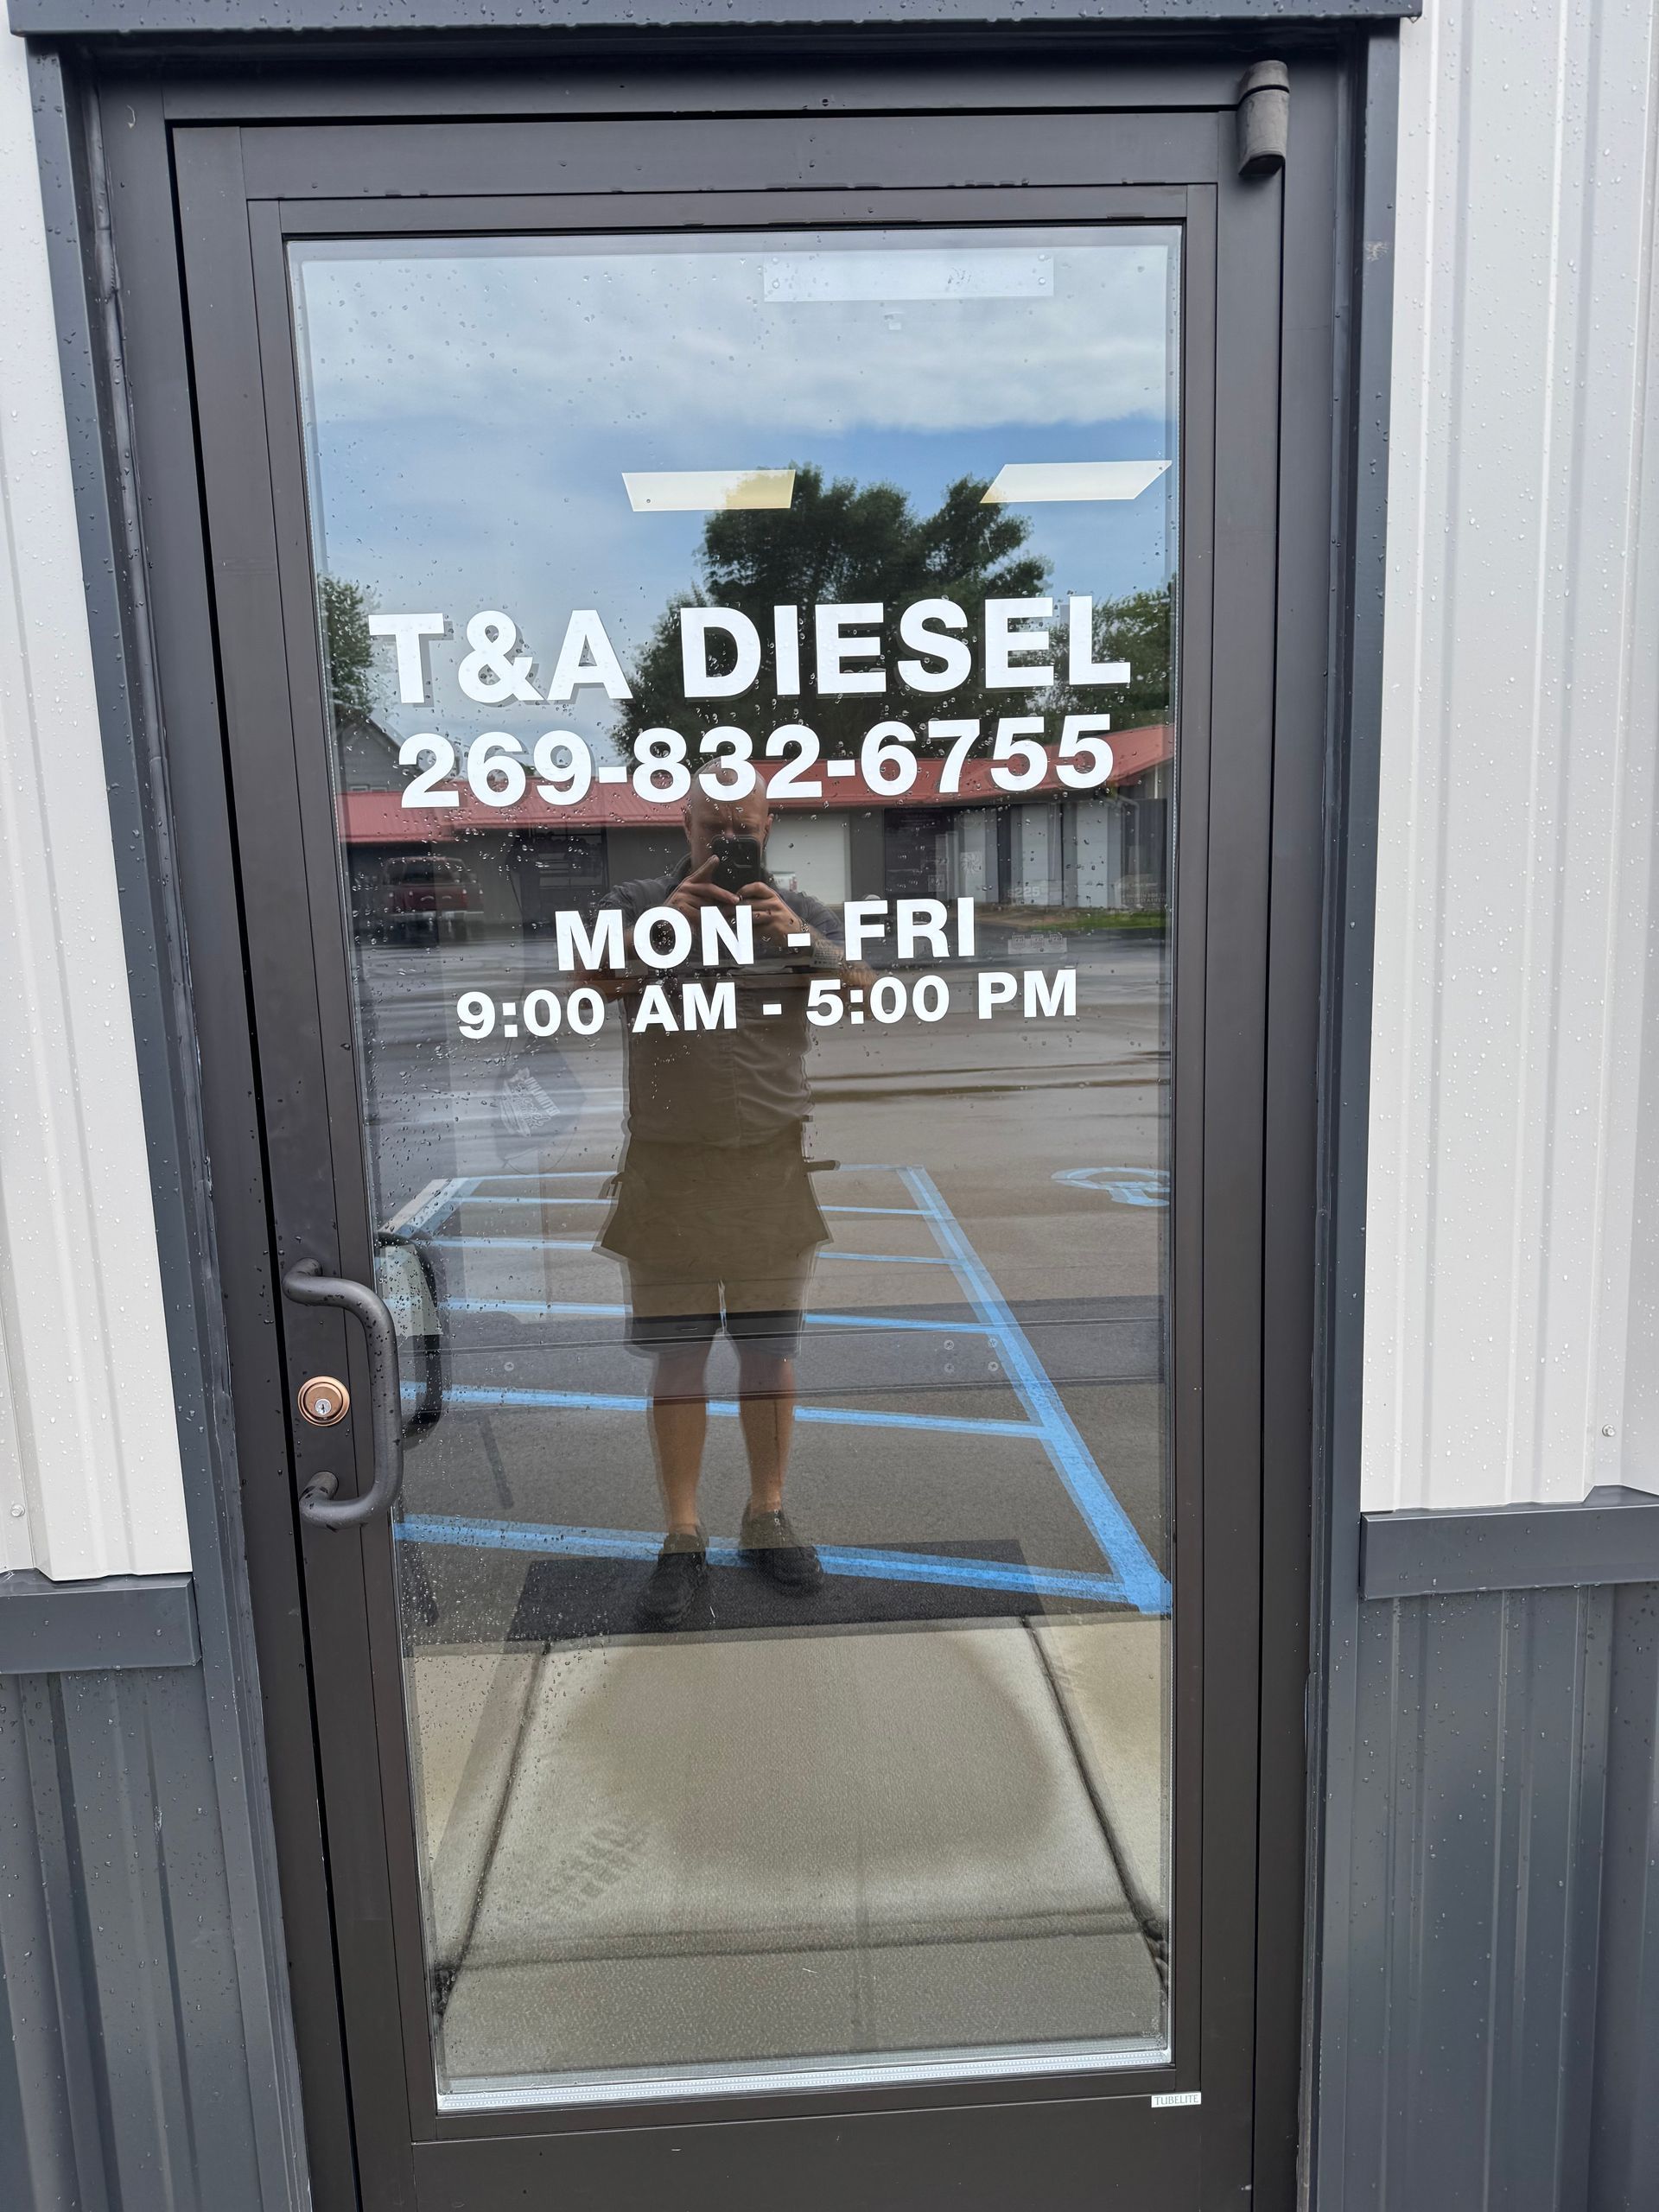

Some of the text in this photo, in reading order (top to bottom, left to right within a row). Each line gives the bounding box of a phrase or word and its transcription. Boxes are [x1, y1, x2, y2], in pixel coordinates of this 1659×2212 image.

[368, 595, 1131, 703] T&A DIESEL
[398, 713, 1115, 809] 269-832-6755
[555, 905, 754, 971] MON
[844, 896, 975, 961] FRI
[456, 988, 605, 1039] 9:00
[632, 982, 738, 1033] AM
[806, 975, 950, 1027] 5:00
[978, 969, 1077, 1020] PM
[1154, 2094, 1199, 2106] TUBELITE
